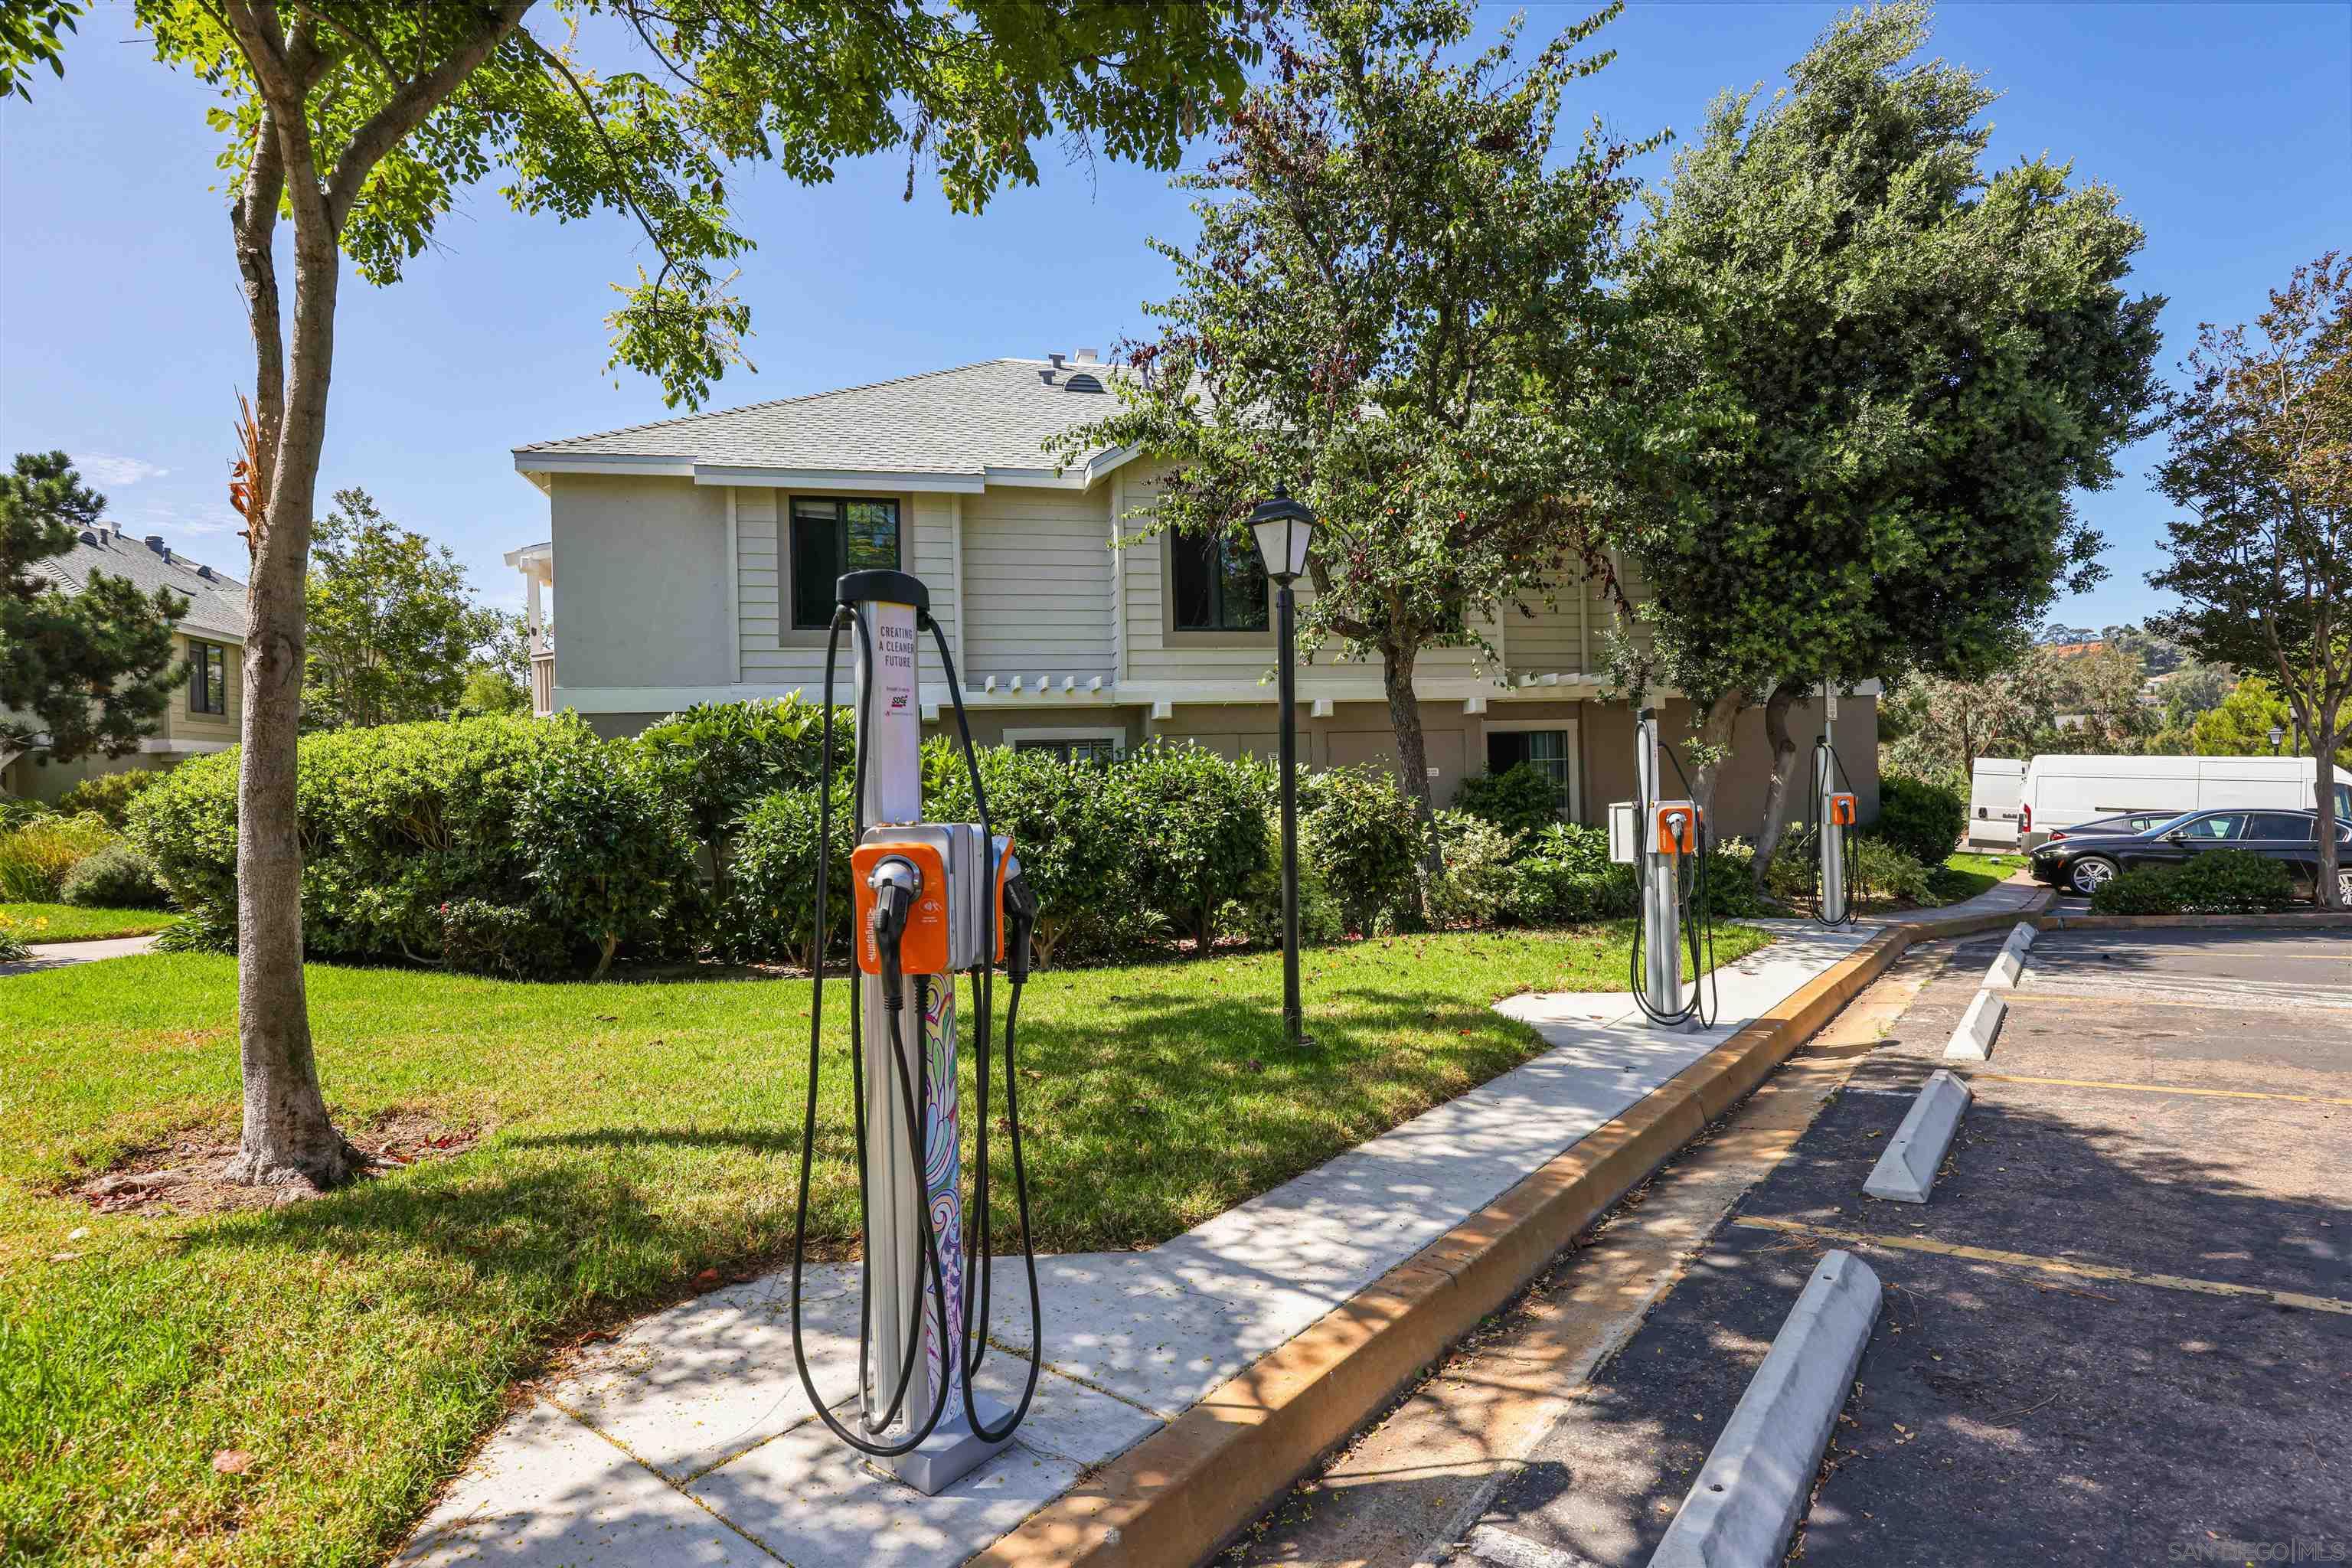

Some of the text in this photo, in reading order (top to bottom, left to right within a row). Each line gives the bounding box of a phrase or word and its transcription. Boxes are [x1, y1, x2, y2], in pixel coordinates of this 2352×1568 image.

[880, 626, 913, 640] CREATING
[879, 640, 913, 654] A CLEANER
[885, 655, 911, 668] FUTURE
